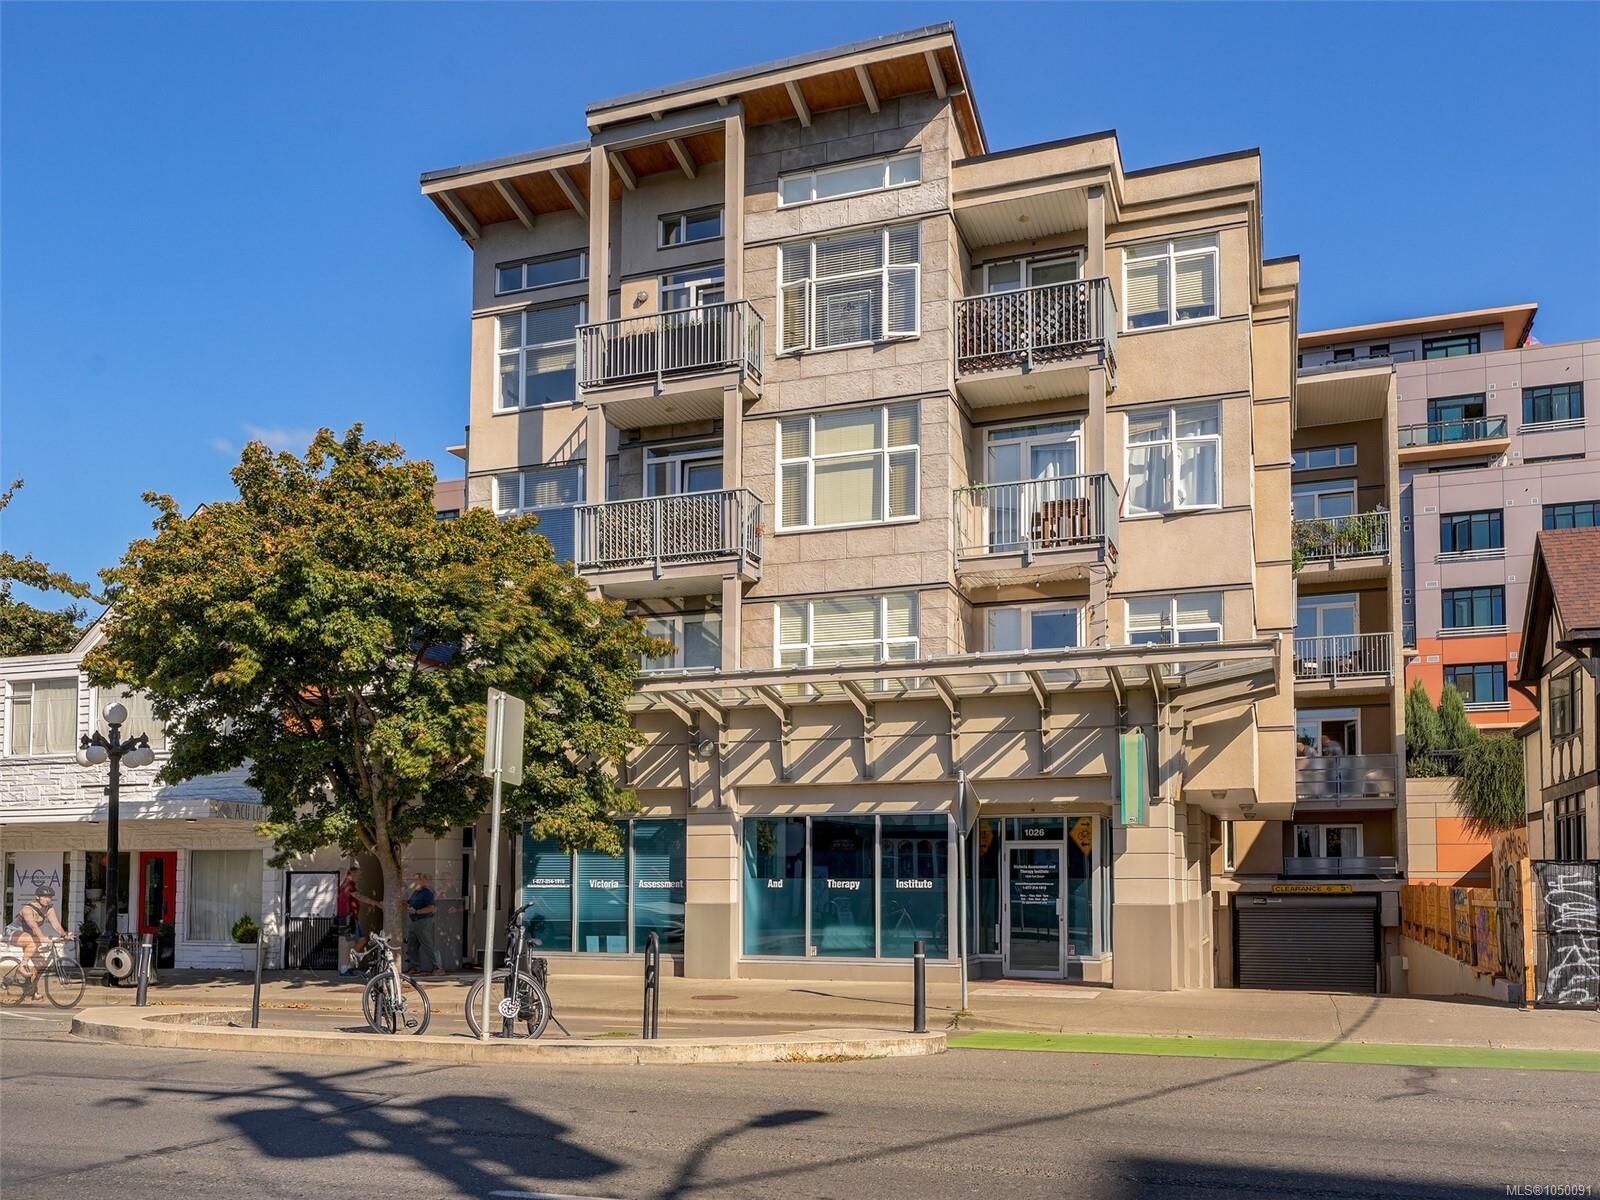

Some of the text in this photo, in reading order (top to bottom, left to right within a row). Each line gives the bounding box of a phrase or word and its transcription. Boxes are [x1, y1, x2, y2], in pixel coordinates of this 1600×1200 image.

[1024, 828, 1045, 837] 1026
[589, 878, 933, 890] Victoria Assessment And Therapy Institute
